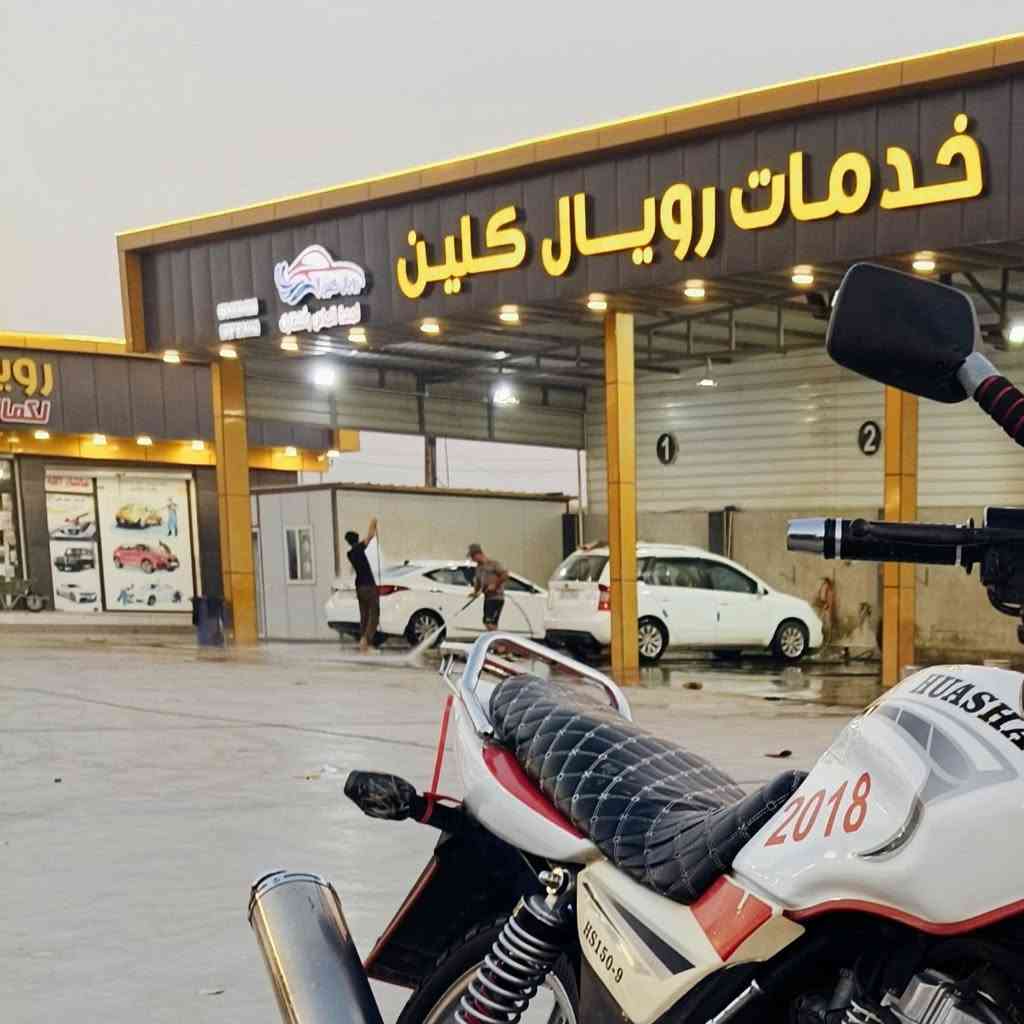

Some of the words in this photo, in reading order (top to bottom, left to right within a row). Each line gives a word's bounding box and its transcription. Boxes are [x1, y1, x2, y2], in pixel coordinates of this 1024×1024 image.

[730, 113, 983, 230] خدمات
[396, 205, 527, 299] كلين
[541, 183, 717, 277] رويال
[863, 425, 877, 452] 2
[764, 771, 873, 847] 2018
[582, 920, 624, 984] HS150-9
